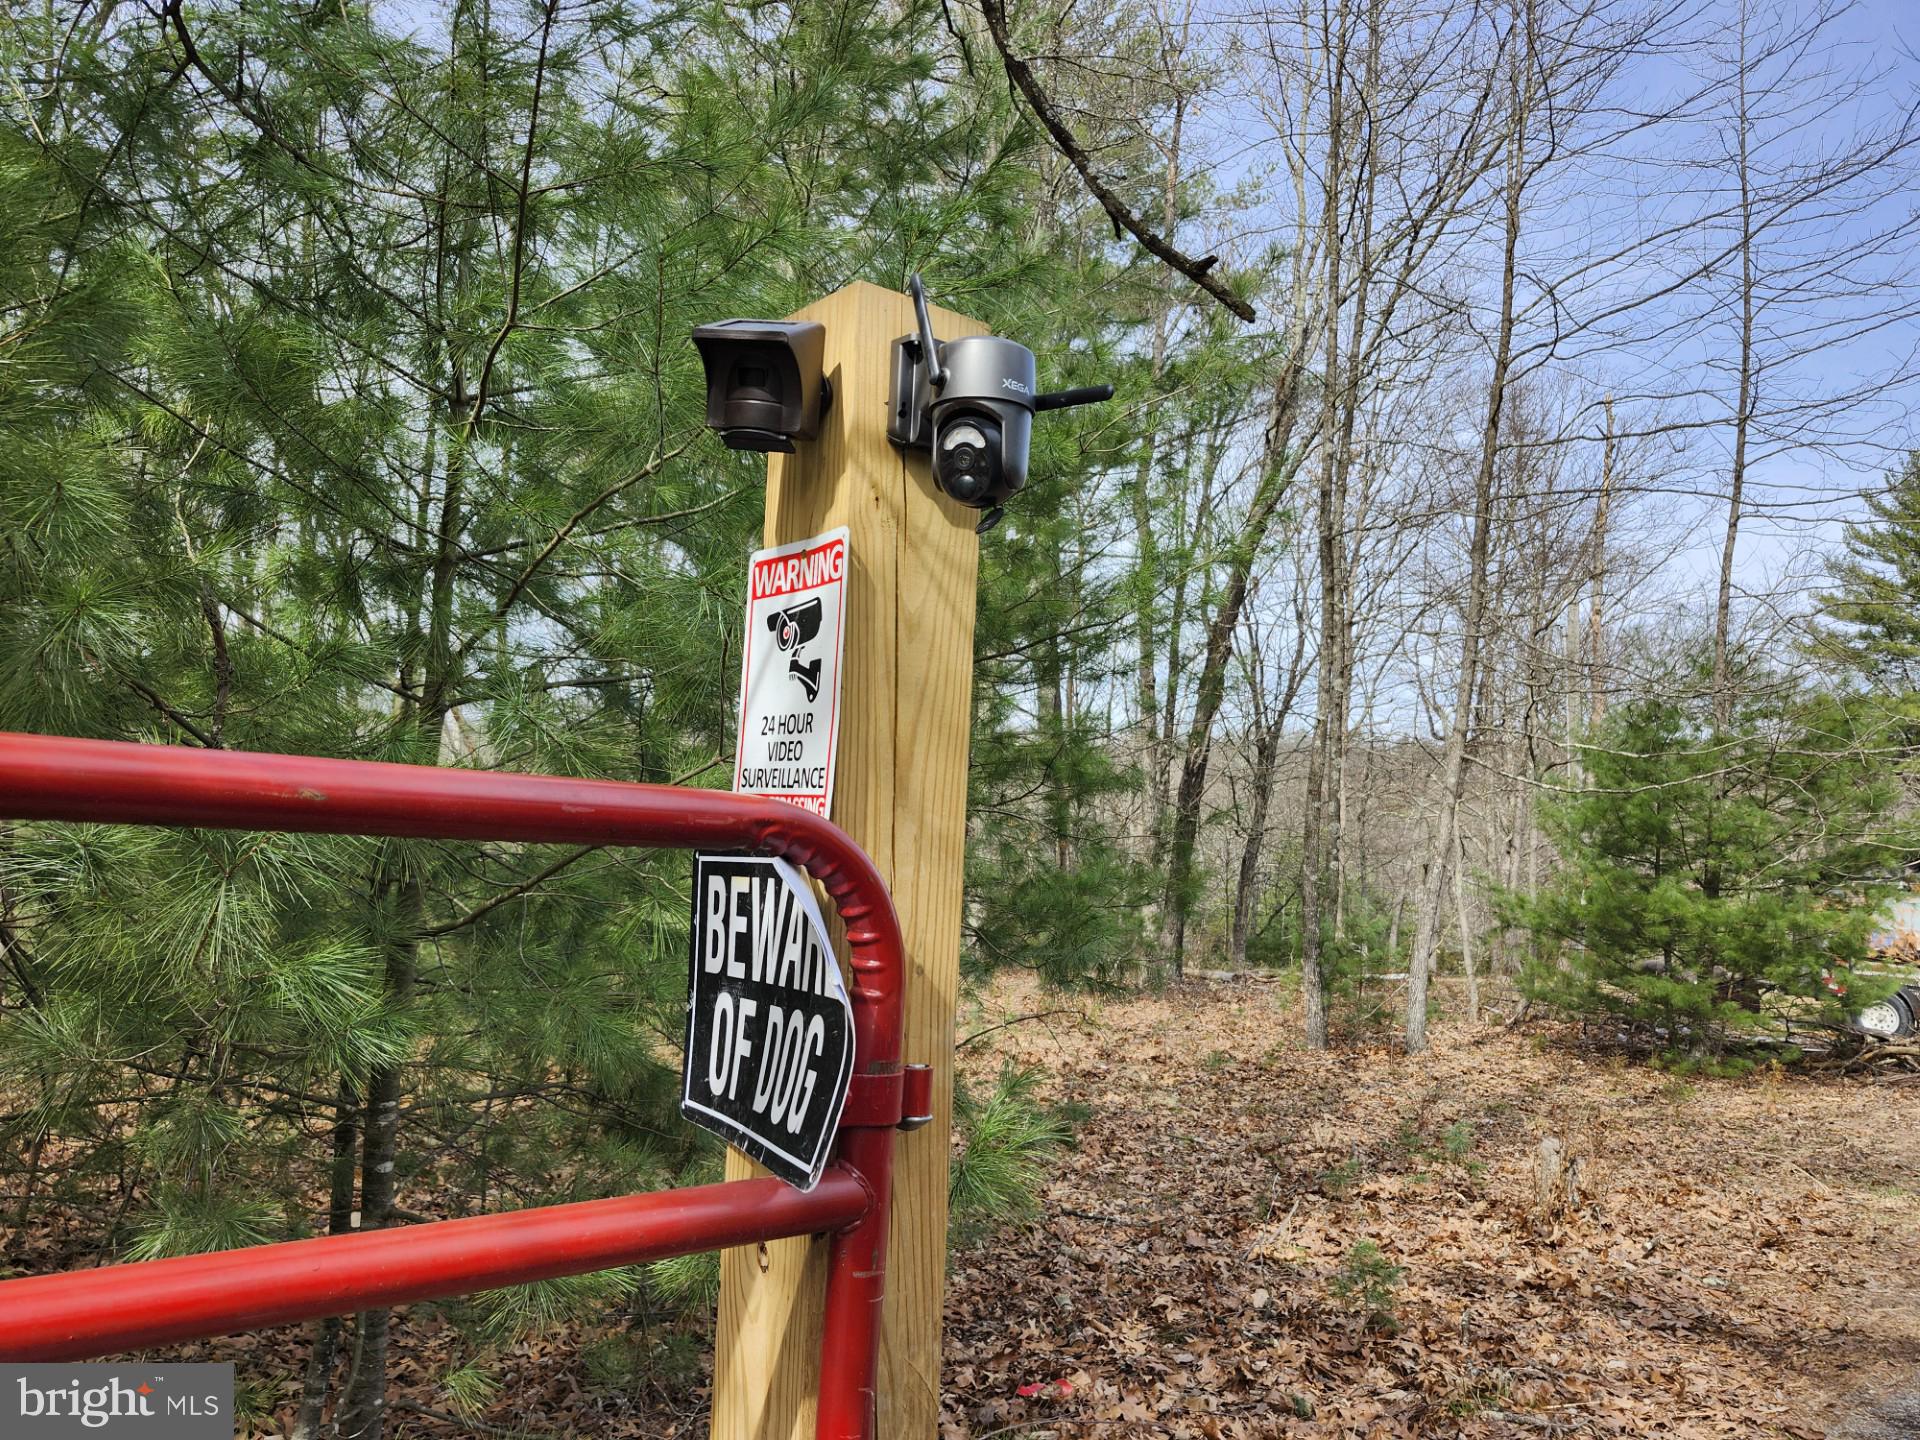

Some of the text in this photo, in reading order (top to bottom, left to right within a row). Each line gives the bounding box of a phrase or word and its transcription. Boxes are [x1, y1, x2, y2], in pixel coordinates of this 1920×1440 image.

[754, 544, 844, 596] WARNING
[761, 712, 814, 736] 24 HOUR
[768, 740, 803, 762] VIDEO
[741, 767, 826, 790] SURVEILLANCE
[709, 992, 825, 1135] OF DOG
